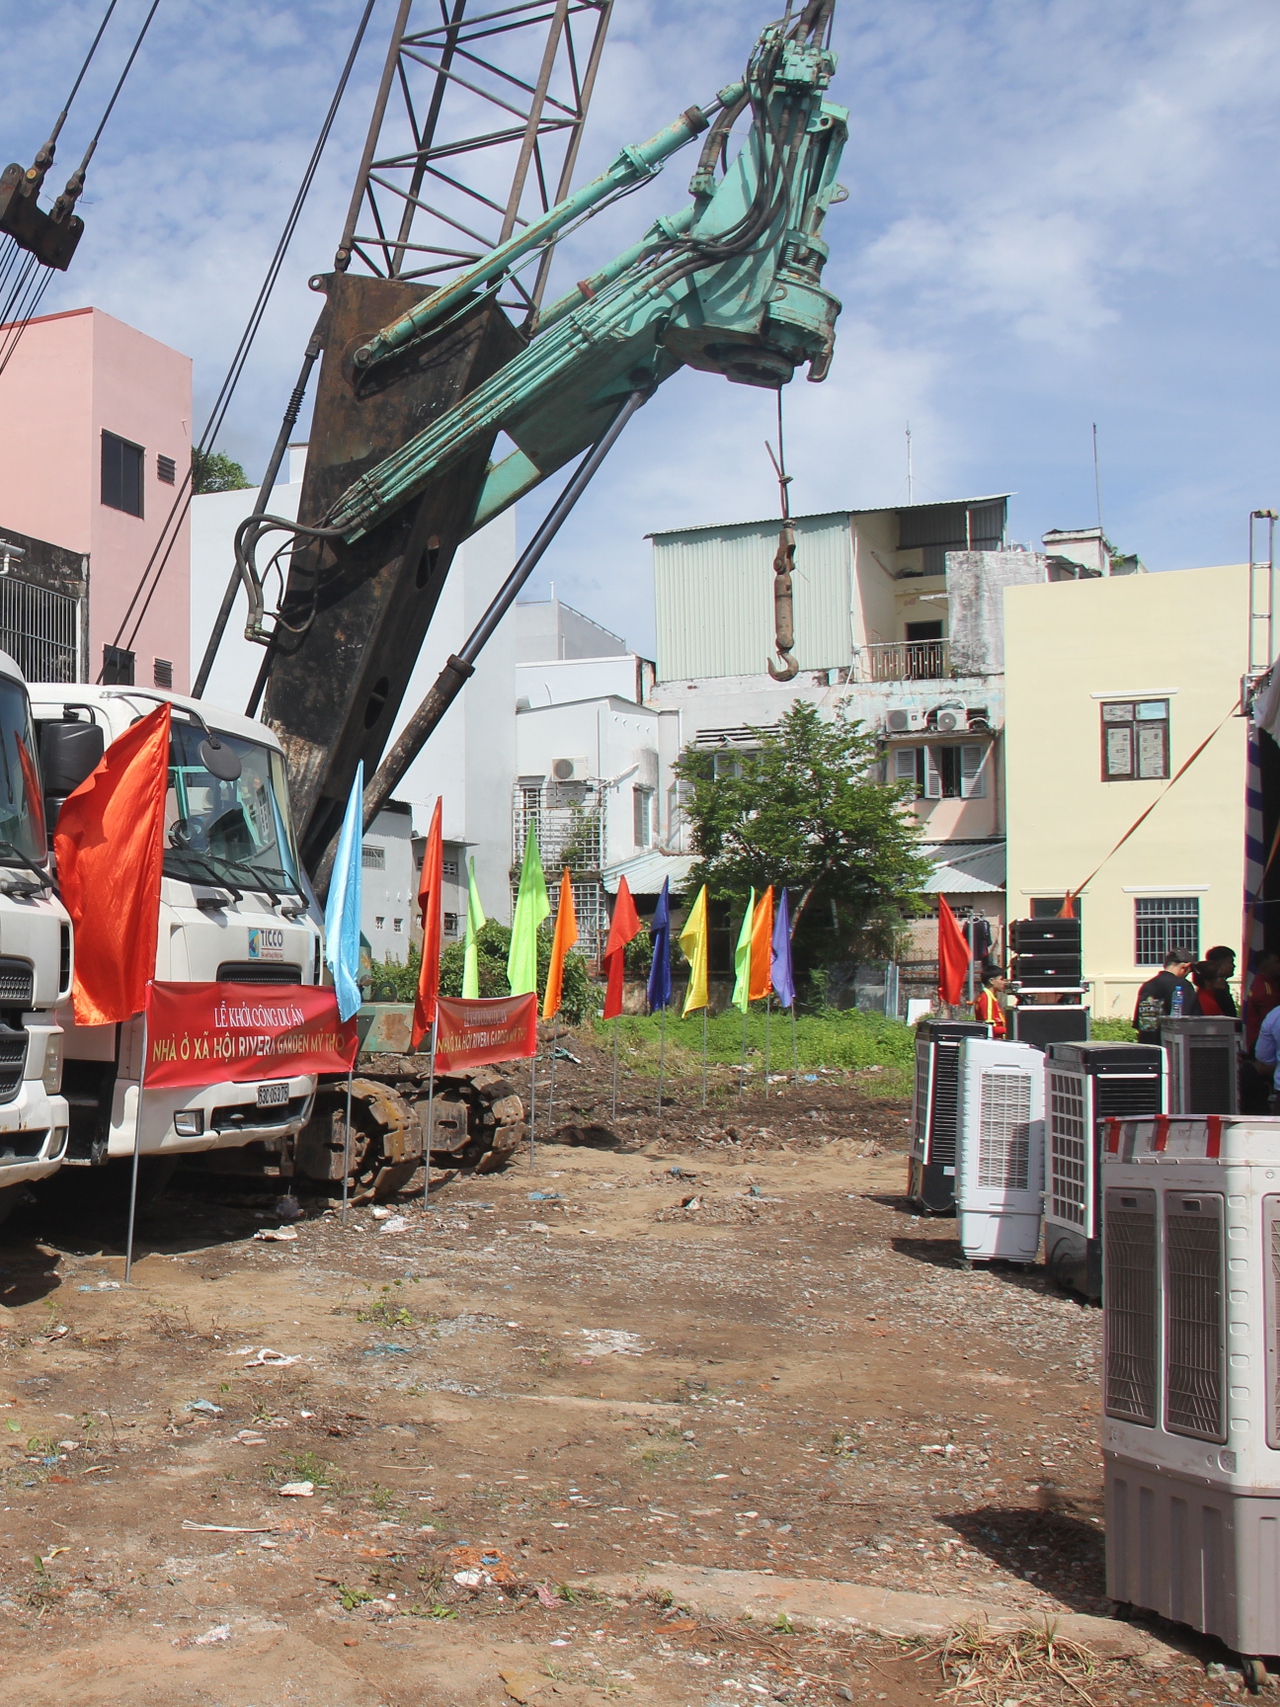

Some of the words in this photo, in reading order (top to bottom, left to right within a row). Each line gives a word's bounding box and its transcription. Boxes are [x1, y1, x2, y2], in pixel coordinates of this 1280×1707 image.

[260, 929, 284, 948] TICCO
[214, 1000, 228, 1028] LỄ
[229, 1002, 252, 1027] KHỞI
[252, 1003, 278, 1027] CÔNG
[278, 1006, 292, 1030] DỰ
[292, 1003, 305, 1026] ÁN
[153, 1034, 178, 1062] NHÀ
[180, 1032, 190, 1061] Ở
[194, 1031, 210, 1060] XÃ
[213, 1031, 236, 1062] HỘI
[238, 1035, 277, 1057] RIVERA
[277, 1033, 309, 1054] GARDEN
[311, 1028, 324, 1052] MỸ
[325, 1033, 345, 1052] THO
